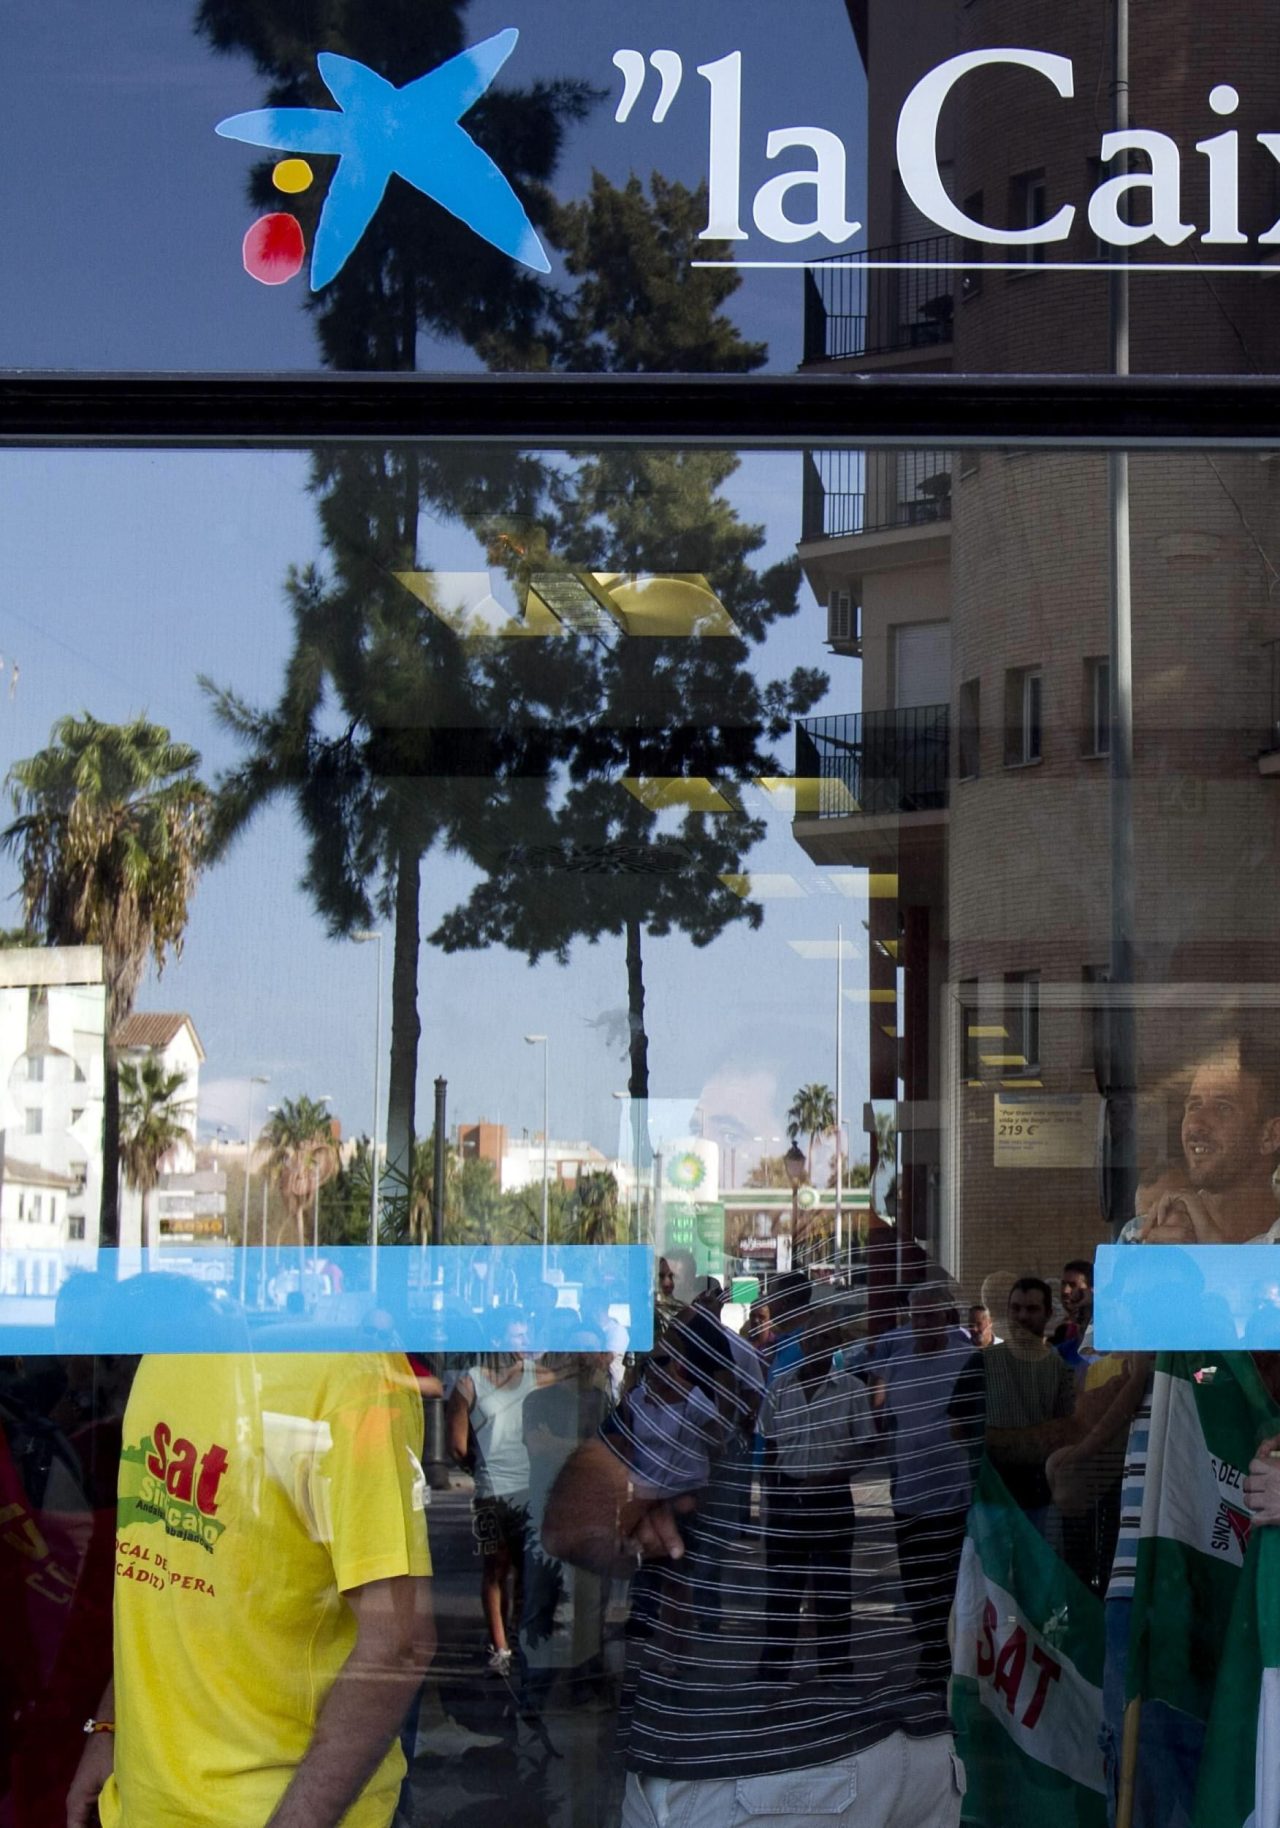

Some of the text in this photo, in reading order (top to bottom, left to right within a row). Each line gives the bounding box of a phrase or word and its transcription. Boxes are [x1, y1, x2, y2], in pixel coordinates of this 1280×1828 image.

[998, 1125, 1022, 1135] 219
[1218, 1463, 1240, 1489] DEL
[116, 1540, 215, 1597] CAL DE PERA
[977, 1596, 1062, 1730] SAT
